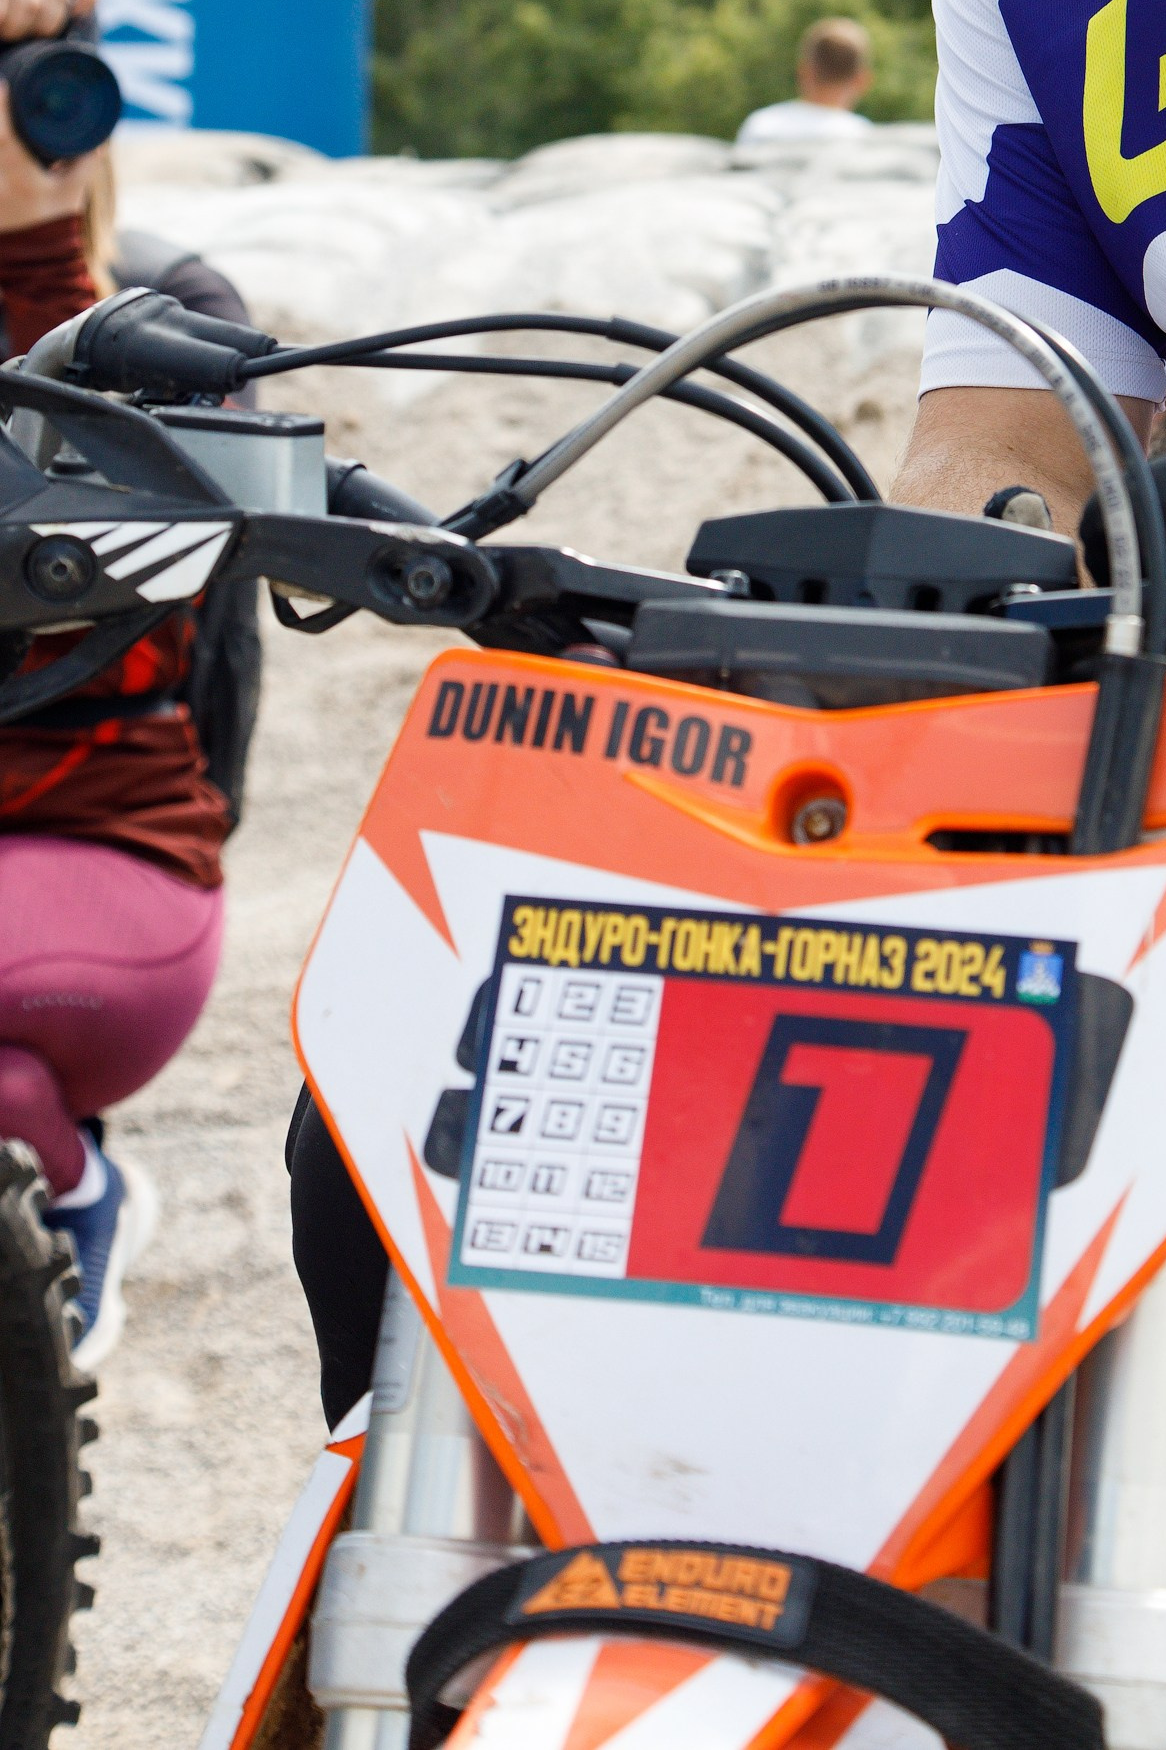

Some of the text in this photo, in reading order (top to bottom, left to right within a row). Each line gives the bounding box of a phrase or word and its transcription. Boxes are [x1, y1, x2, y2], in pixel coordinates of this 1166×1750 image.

[427, 681, 755, 788] DUNIN IGOR
[911, 940, 1006, 998] 2024
[514, 977, 654, 1025] 1 2 3
[497, 1037, 645, 1084] 4 5 6
[490, 1096, 638, 1144] 7 8 9
[700, 1013, 968, 1266] 1
[479, 1160, 631, 1202] 10 11 12
[470, 1220, 624, 1263] 13 14 15
[618, 1548, 792, 1604] ENDURO
[621, 1583, 784, 1631] ELEMENT
